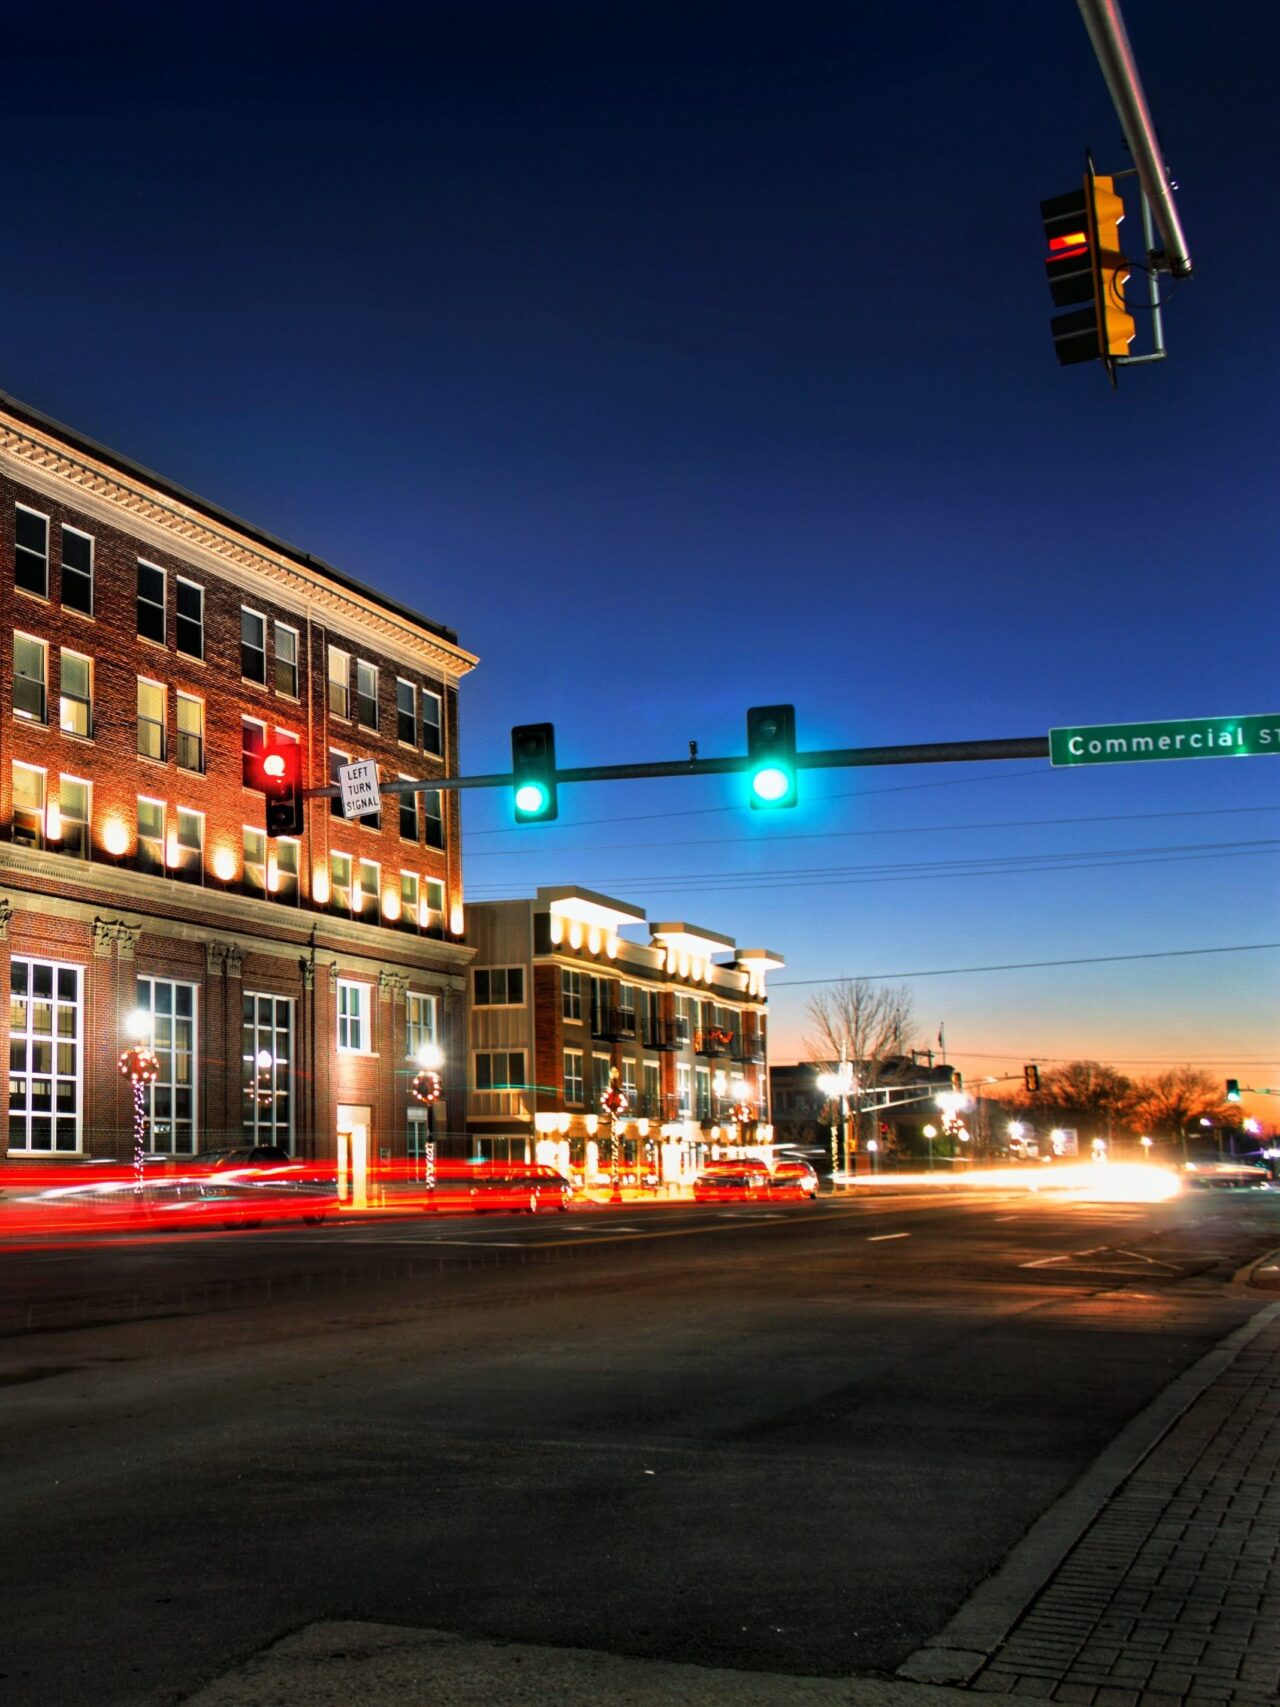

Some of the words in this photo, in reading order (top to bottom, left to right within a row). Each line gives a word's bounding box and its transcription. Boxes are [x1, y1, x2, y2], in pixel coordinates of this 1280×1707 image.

[1068, 727, 1245, 756] Commercial
[347, 766, 368, 781] LEFT
[348, 784, 372, 796] TURN
[346, 796, 379, 812] SIGNAL
